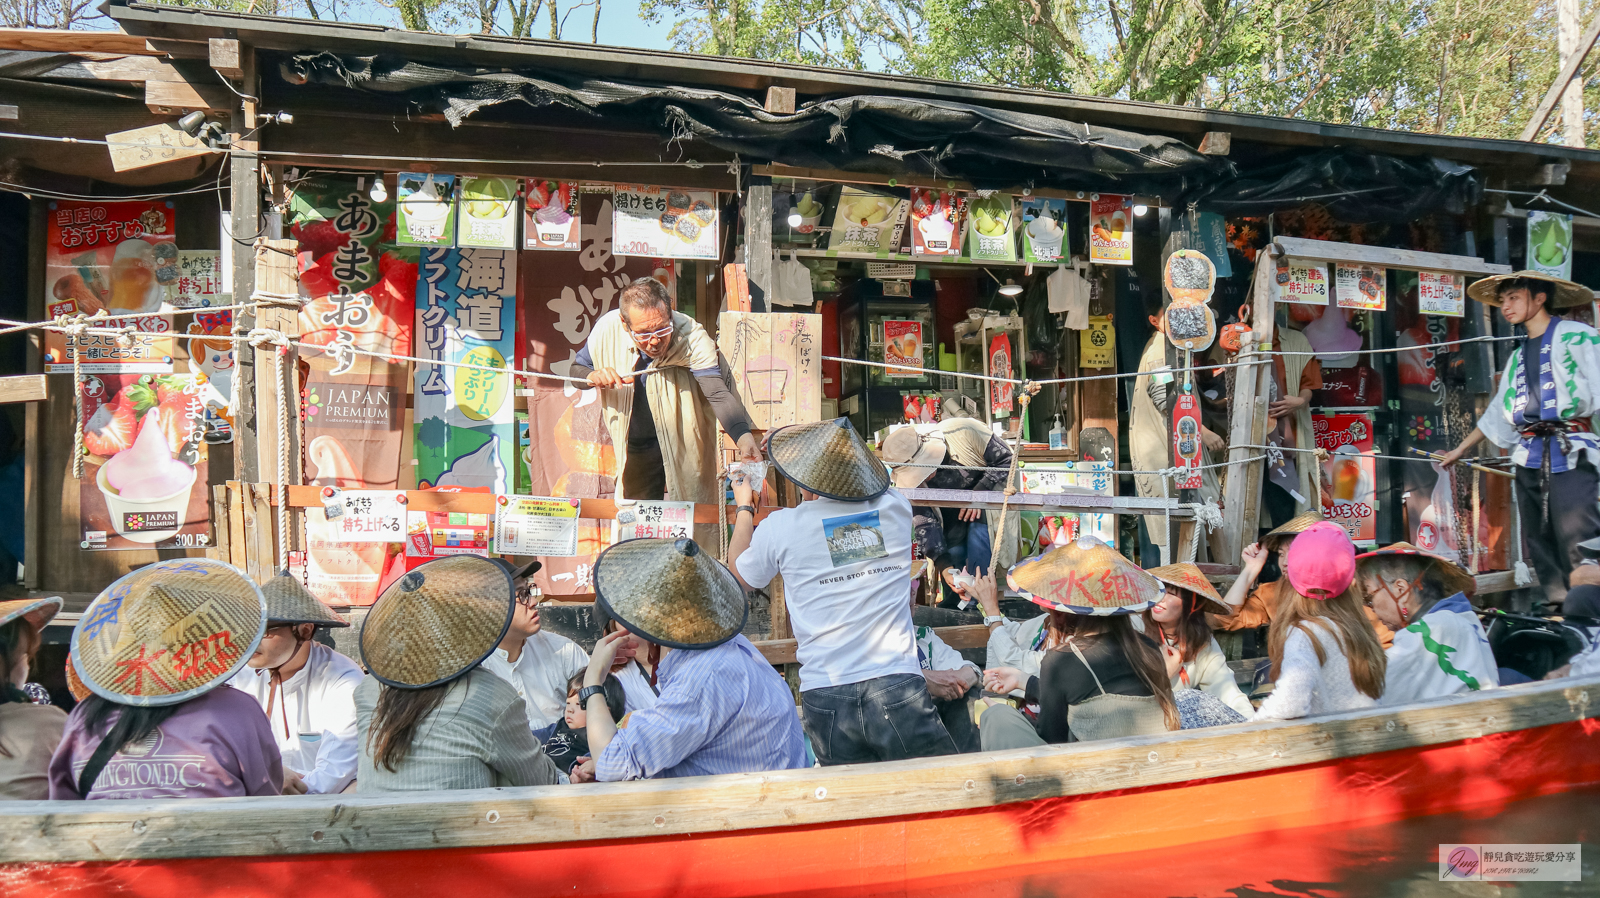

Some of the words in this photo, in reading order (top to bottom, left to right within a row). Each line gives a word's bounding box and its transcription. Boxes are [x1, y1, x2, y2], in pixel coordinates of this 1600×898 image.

[56, 206, 107, 226] 当店の
[61, 219, 145, 248] おすすめ
[471, 223, 502, 236] 抹茶
[844, 227, 879, 241] 抹茶
[467, 234, 505, 242] ソフトクリーム
[979, 238, 1004, 250] 抹茶
[1034, 245, 1060, 257] 北海道
[1291, 267, 1308, 276] あげもち
[1308, 268, 1325, 280] 運気
[321, 193, 381, 376] あまおう
[53, 302, 73, 315] 名物
[800, 333, 814, 374] おばけの
[464, 353, 484, 401] たっぷり
[326, 388, 391, 406] JAPAN
[325, 405, 389, 419] PREMIUM
[346, 496, 372, 507] あげもち
[146, 513, 175, 521] JAPAN
[638, 503, 662, 515] あげもち
[663, 507, 687, 519] 成績
[175, 533, 193, 546] 300
[844, 530, 861, 539] THE
[833, 537, 862, 547] NORTH
[843, 543, 865, 552] FACE
[819, 576, 845, 585] NEVER
[846, 571, 866, 580] STOP
[867, 564, 903, 575] EXPLORING
